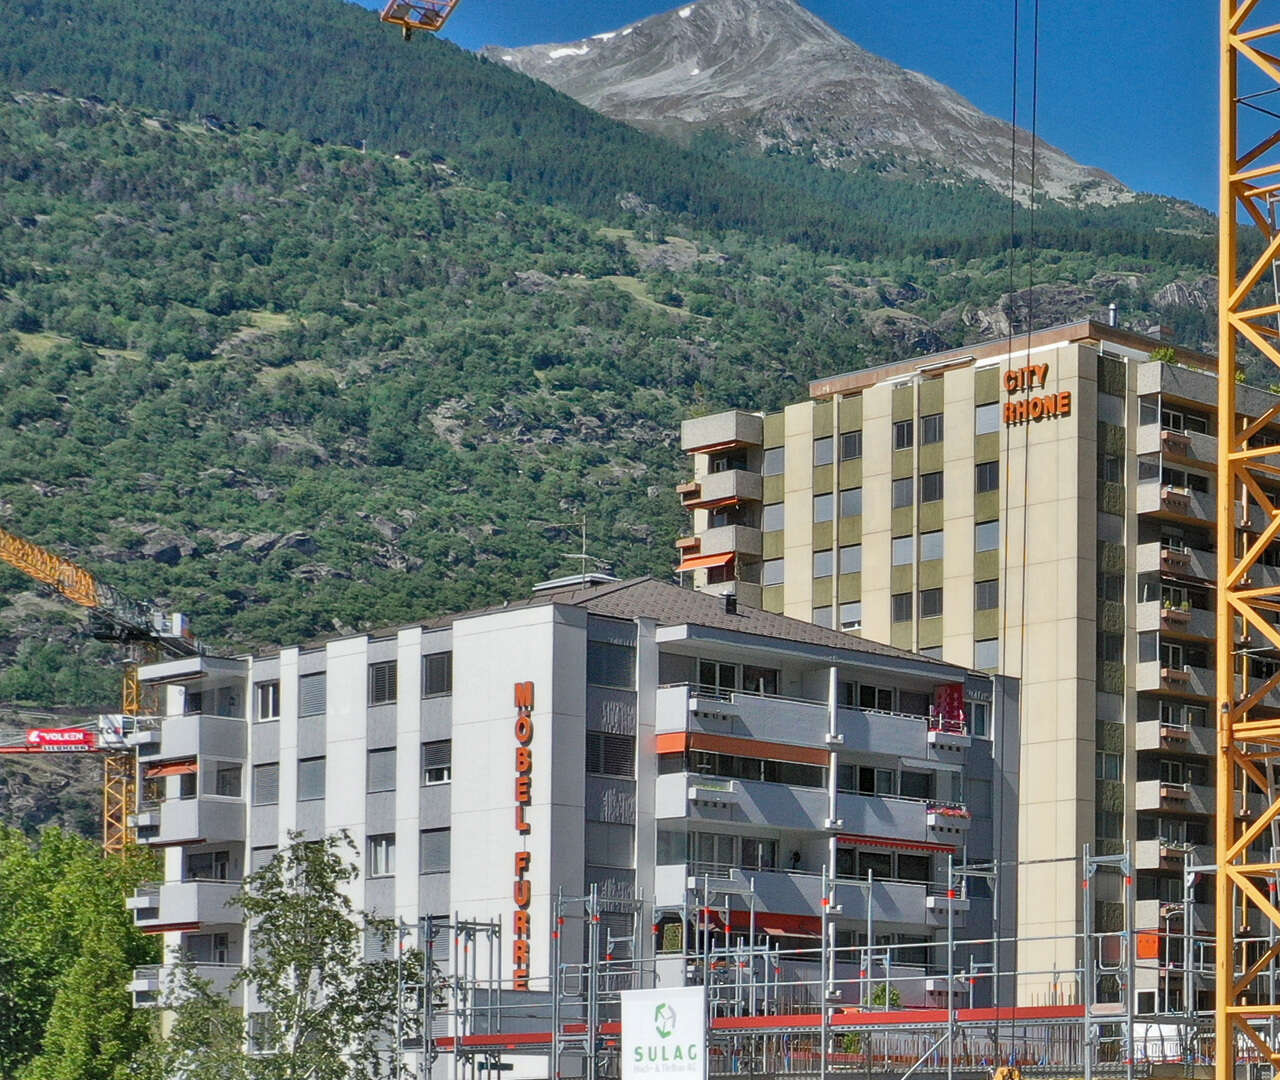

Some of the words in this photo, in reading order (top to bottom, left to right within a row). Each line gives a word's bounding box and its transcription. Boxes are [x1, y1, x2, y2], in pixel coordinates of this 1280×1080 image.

[1003, 363, 1049, 393] CITY
[1003, 391, 1072, 425] RHONE
[513, 681, 534, 835] MÖBEL
[634, 1044, 697, 1062] SULAG
